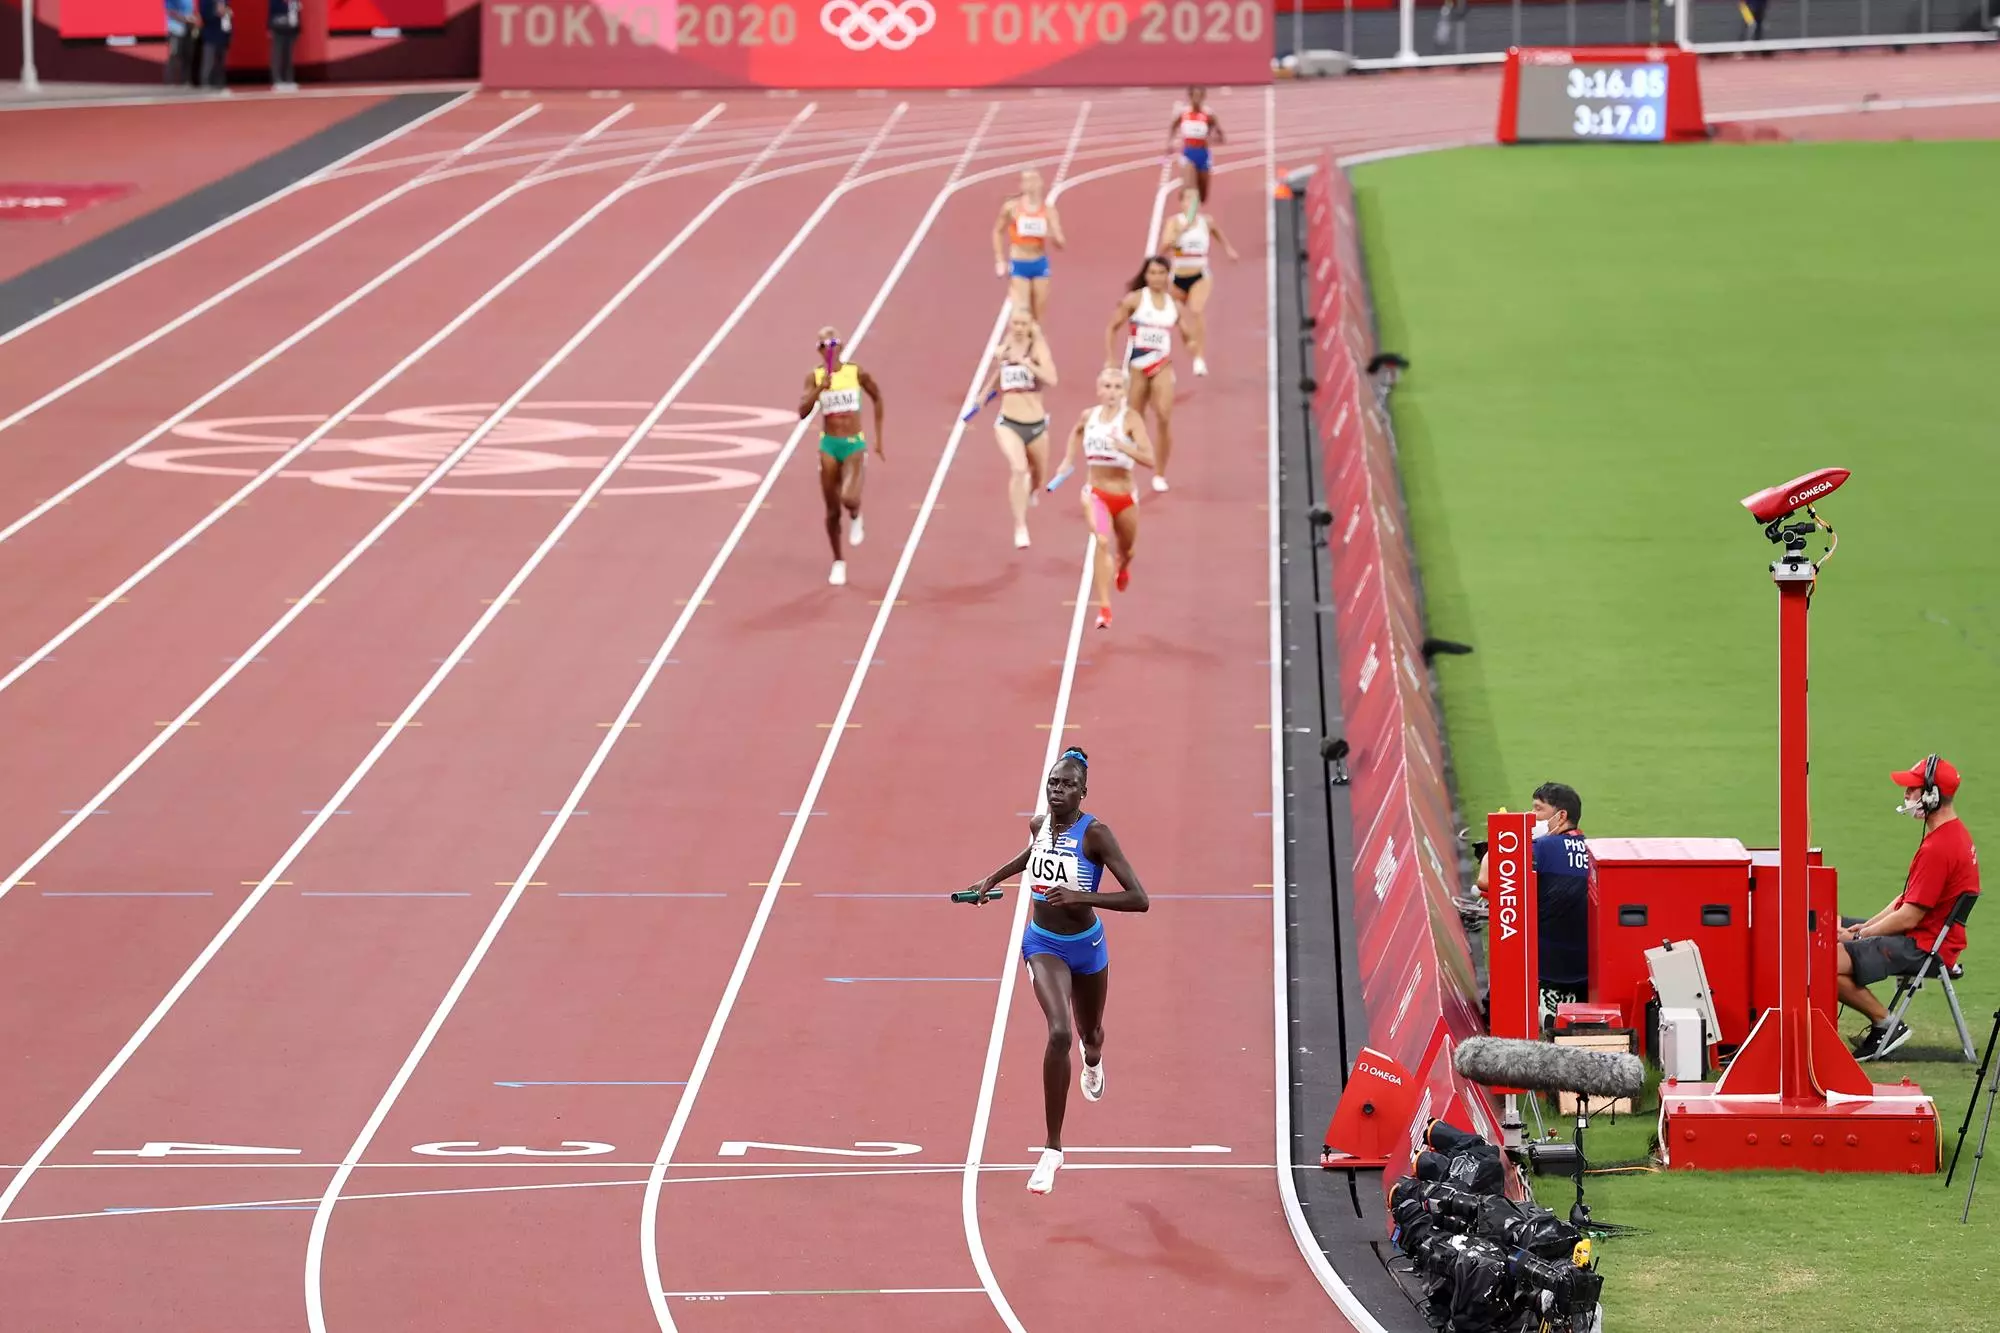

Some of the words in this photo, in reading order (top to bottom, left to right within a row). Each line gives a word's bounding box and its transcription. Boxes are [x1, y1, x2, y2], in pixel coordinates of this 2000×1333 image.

[491, 4, 660, 46] TOKYO
[676, 4, 797, 46] 2020
[960, 3, 1128, 44] TOKYO
[1139, 2, 1264, 43] 2020
[1573, 105, 1657, 135] 3:17.0
[1799, 480, 1833, 500] OMEGA
[1032, 857, 1069, 883] USA
[1499, 859, 1518, 941] OMEGA
[1369, 1067, 1402, 1086] OMEGA
[93, 1142, 302, 1157] 4
[411, 1141, 616, 1157] 3
[718, 1141, 923, 1157] 2
